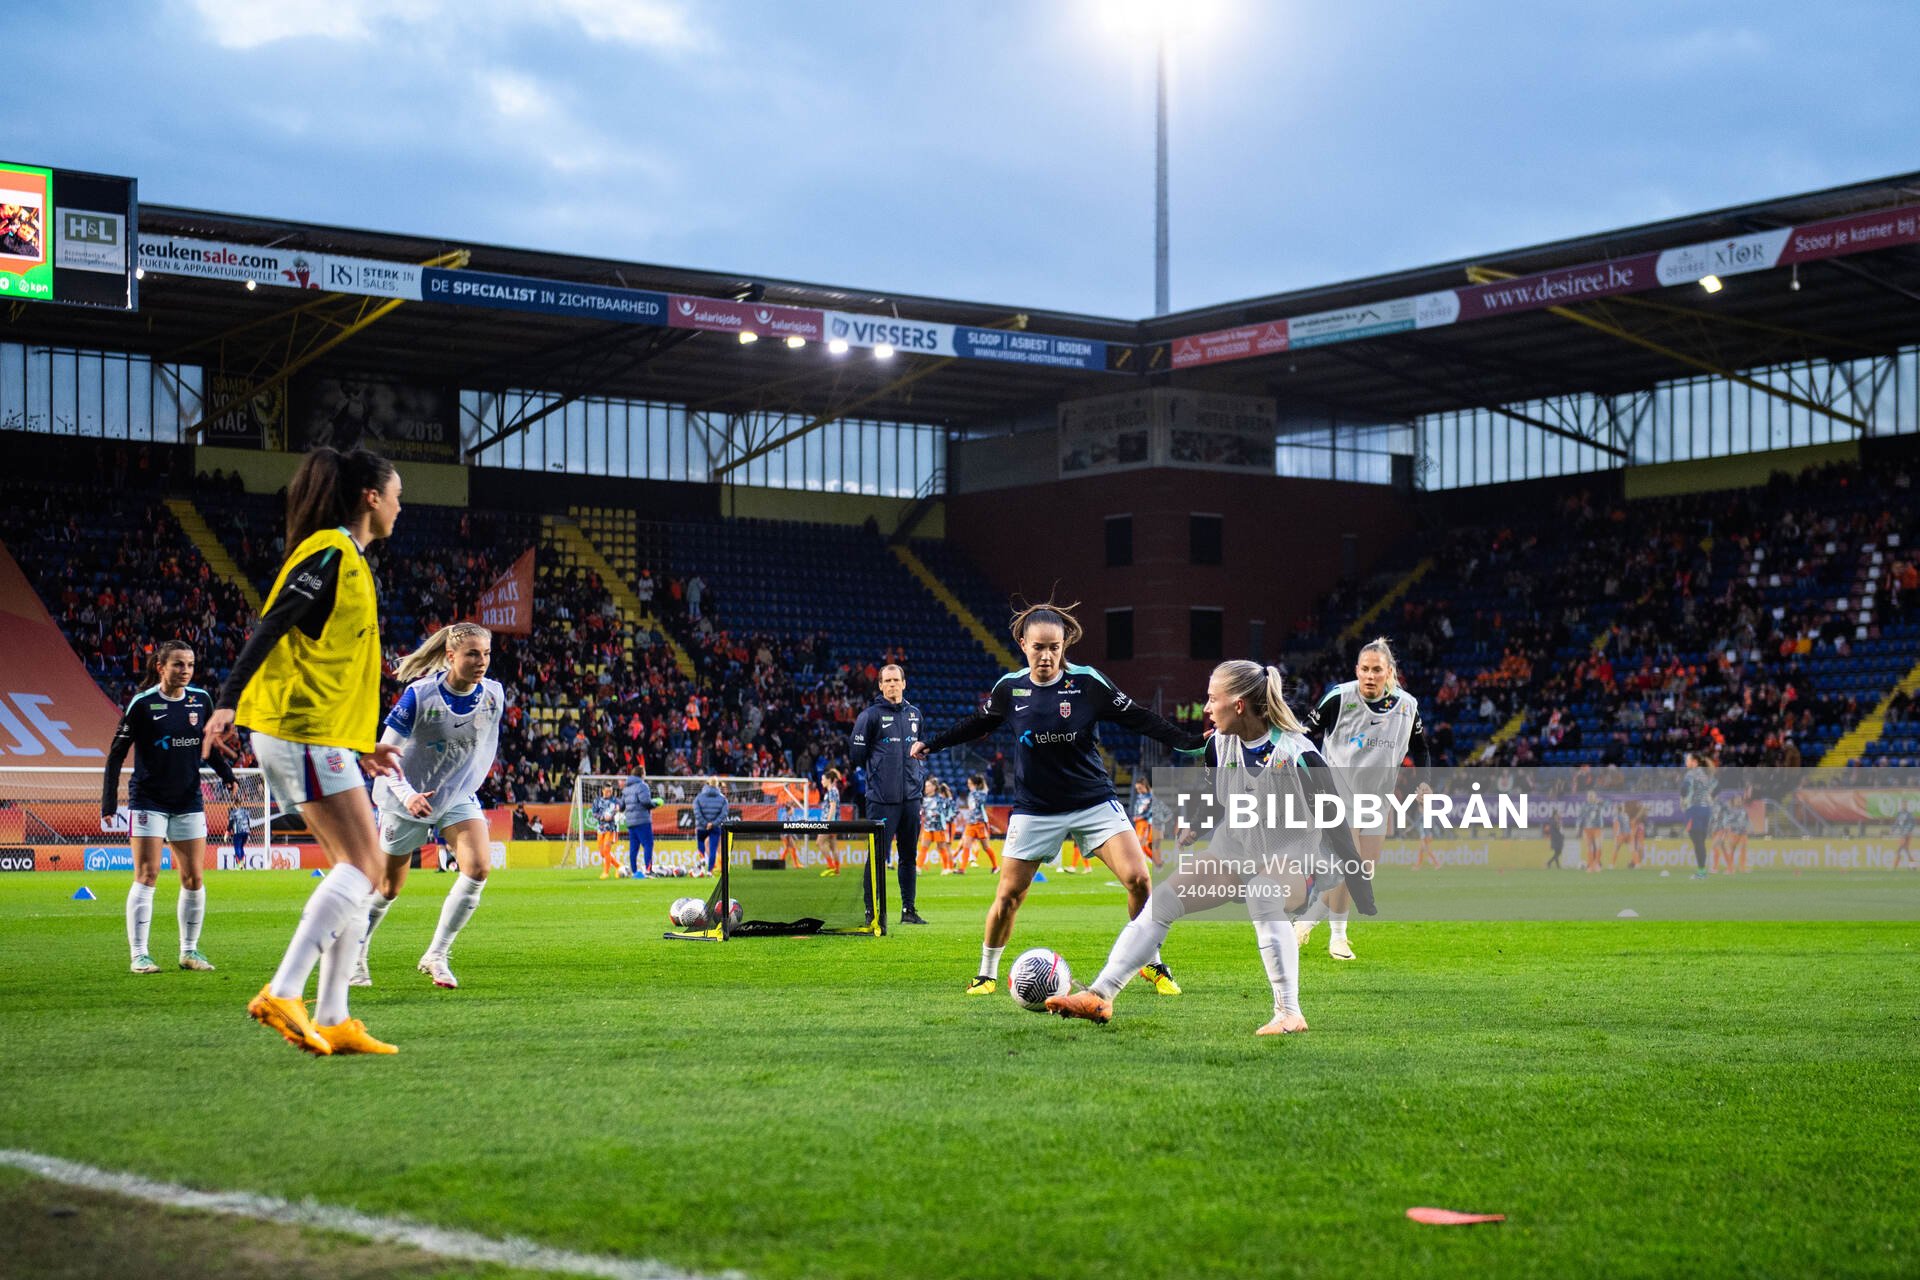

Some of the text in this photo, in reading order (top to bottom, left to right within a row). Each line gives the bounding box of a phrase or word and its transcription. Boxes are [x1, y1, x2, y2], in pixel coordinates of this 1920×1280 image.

[69, 218, 113, 241] H&L
[1795, 217, 1915, 252] Scoor je kamer bij
[363, 267, 414, 282] STERK IN
[30, 282, 48, 292] kpn
[431, 278, 659, 316] DE SPECIALIST IN ZICHTBAARHEID
[1482, 263, 1634, 310] www.desiree.be
[694, 311, 742, 328] salarisjobs
[771, 319, 817, 336] salarisjobs
[852, 320, 938, 350] VISSERS
[967, 332, 1092, 356] SLOOP ASBEST BODEM
[212, 409, 248, 433] NAC
[404, 421, 444, 442] 2013
[172, 737, 200, 747] teleno
[1035, 731, 1077, 744] telenor
[783, 822, 828, 830] BAZOOKAGOAL
[1824, 844, 1860, 867] het
